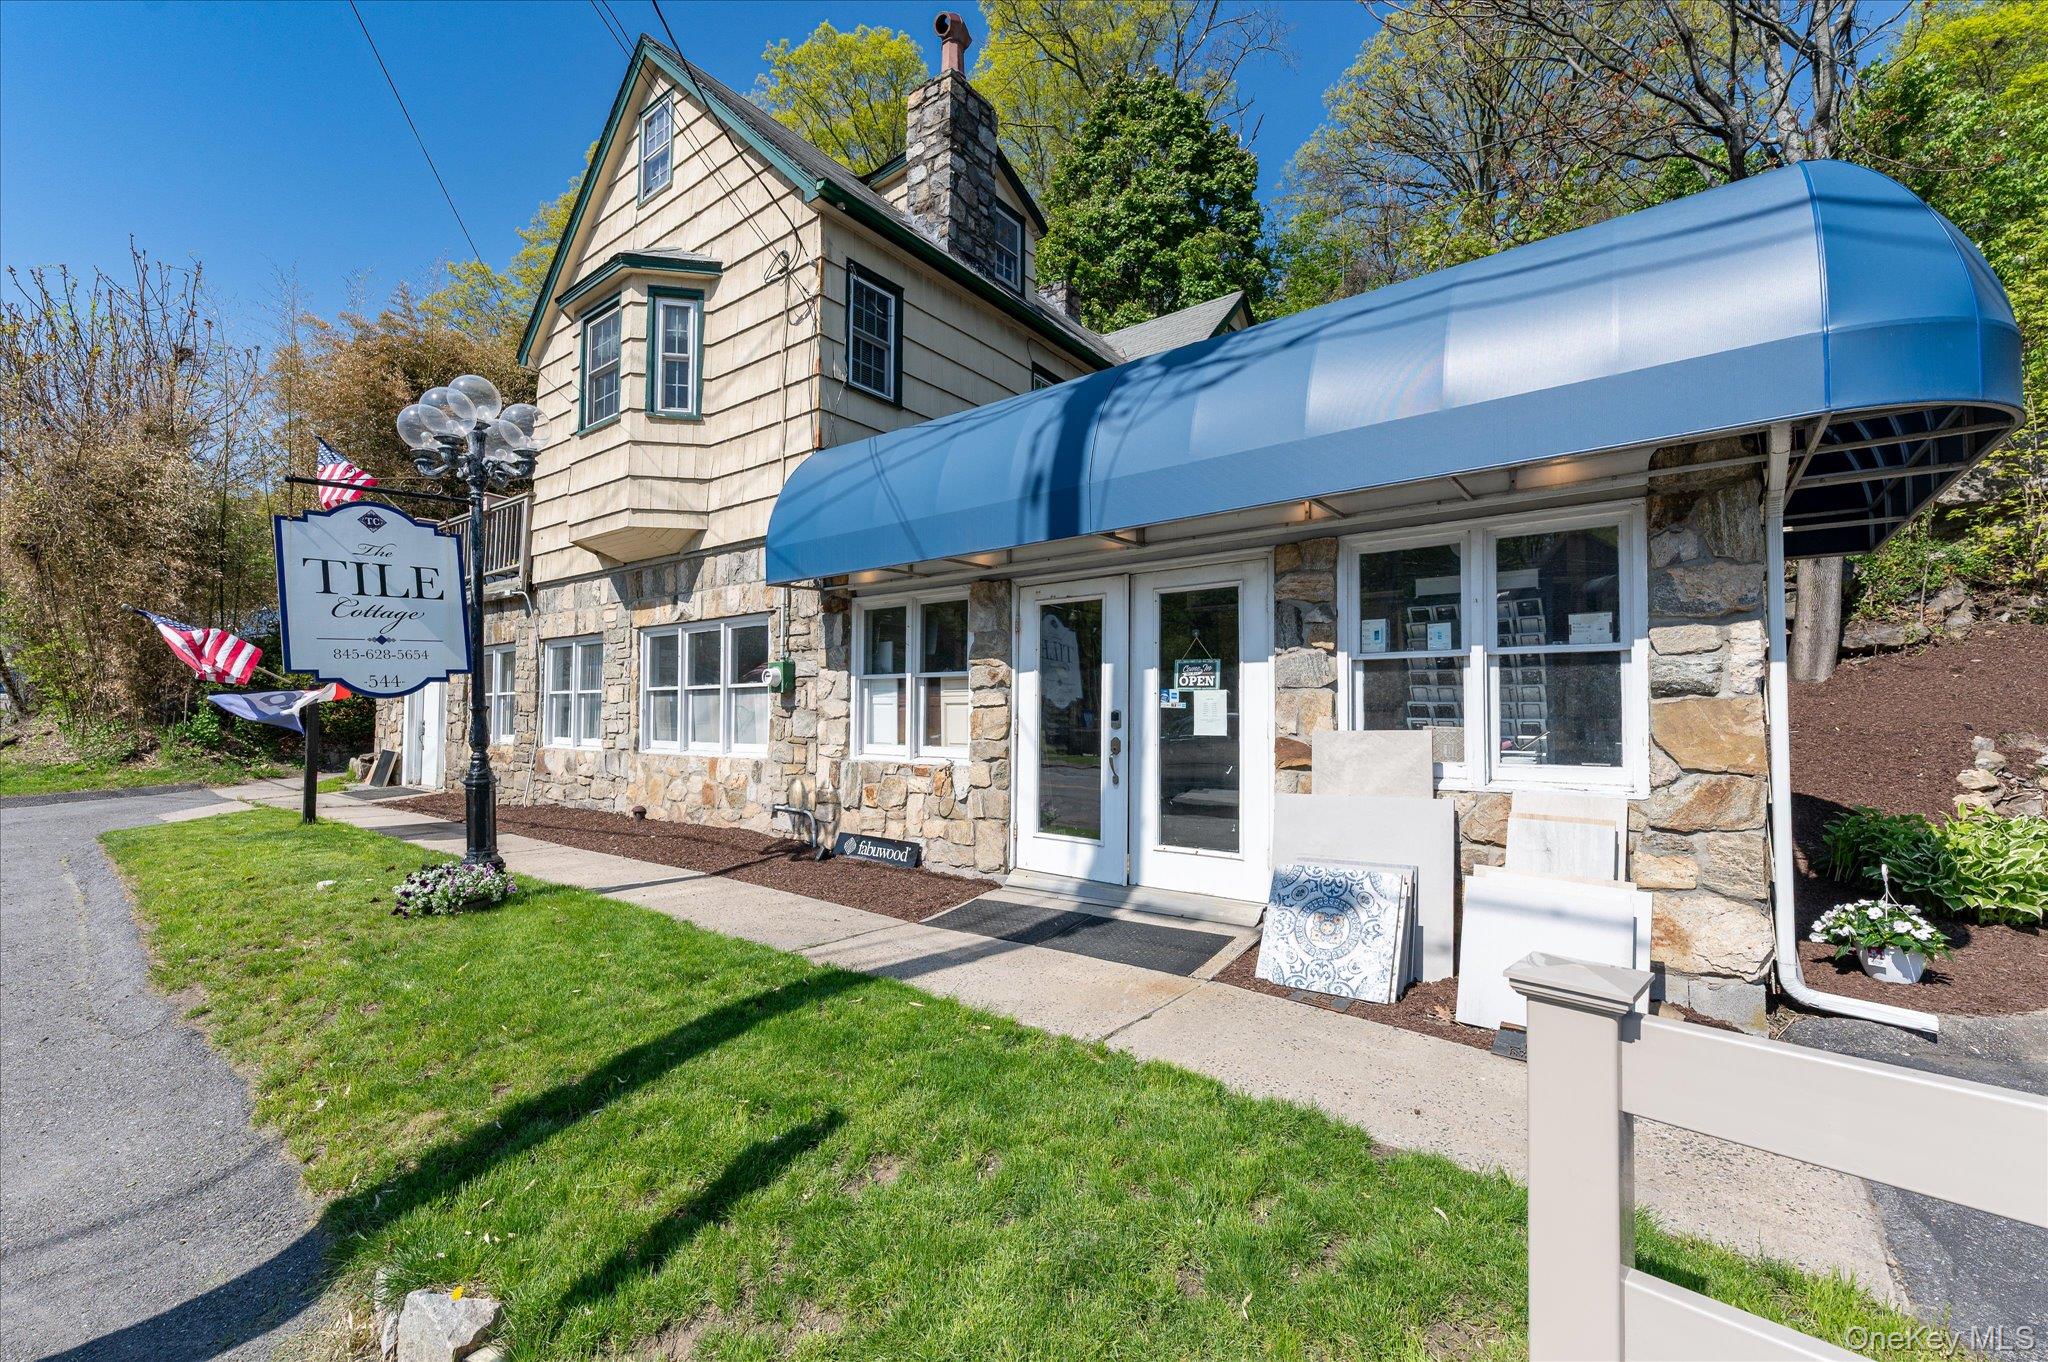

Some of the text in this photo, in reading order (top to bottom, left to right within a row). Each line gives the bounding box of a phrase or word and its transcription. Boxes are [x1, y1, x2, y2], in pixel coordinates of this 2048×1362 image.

[364, 516, 380, 526] TC
[352, 543, 398, 558] The
[302, 557, 445, 600] TILE
[331, 596, 425, 635] Cottage
[333, 648, 430, 660] 845-628-5654
[1178, 675, 1216, 687] OPEN
[857, 840, 909, 862] fabuwood
